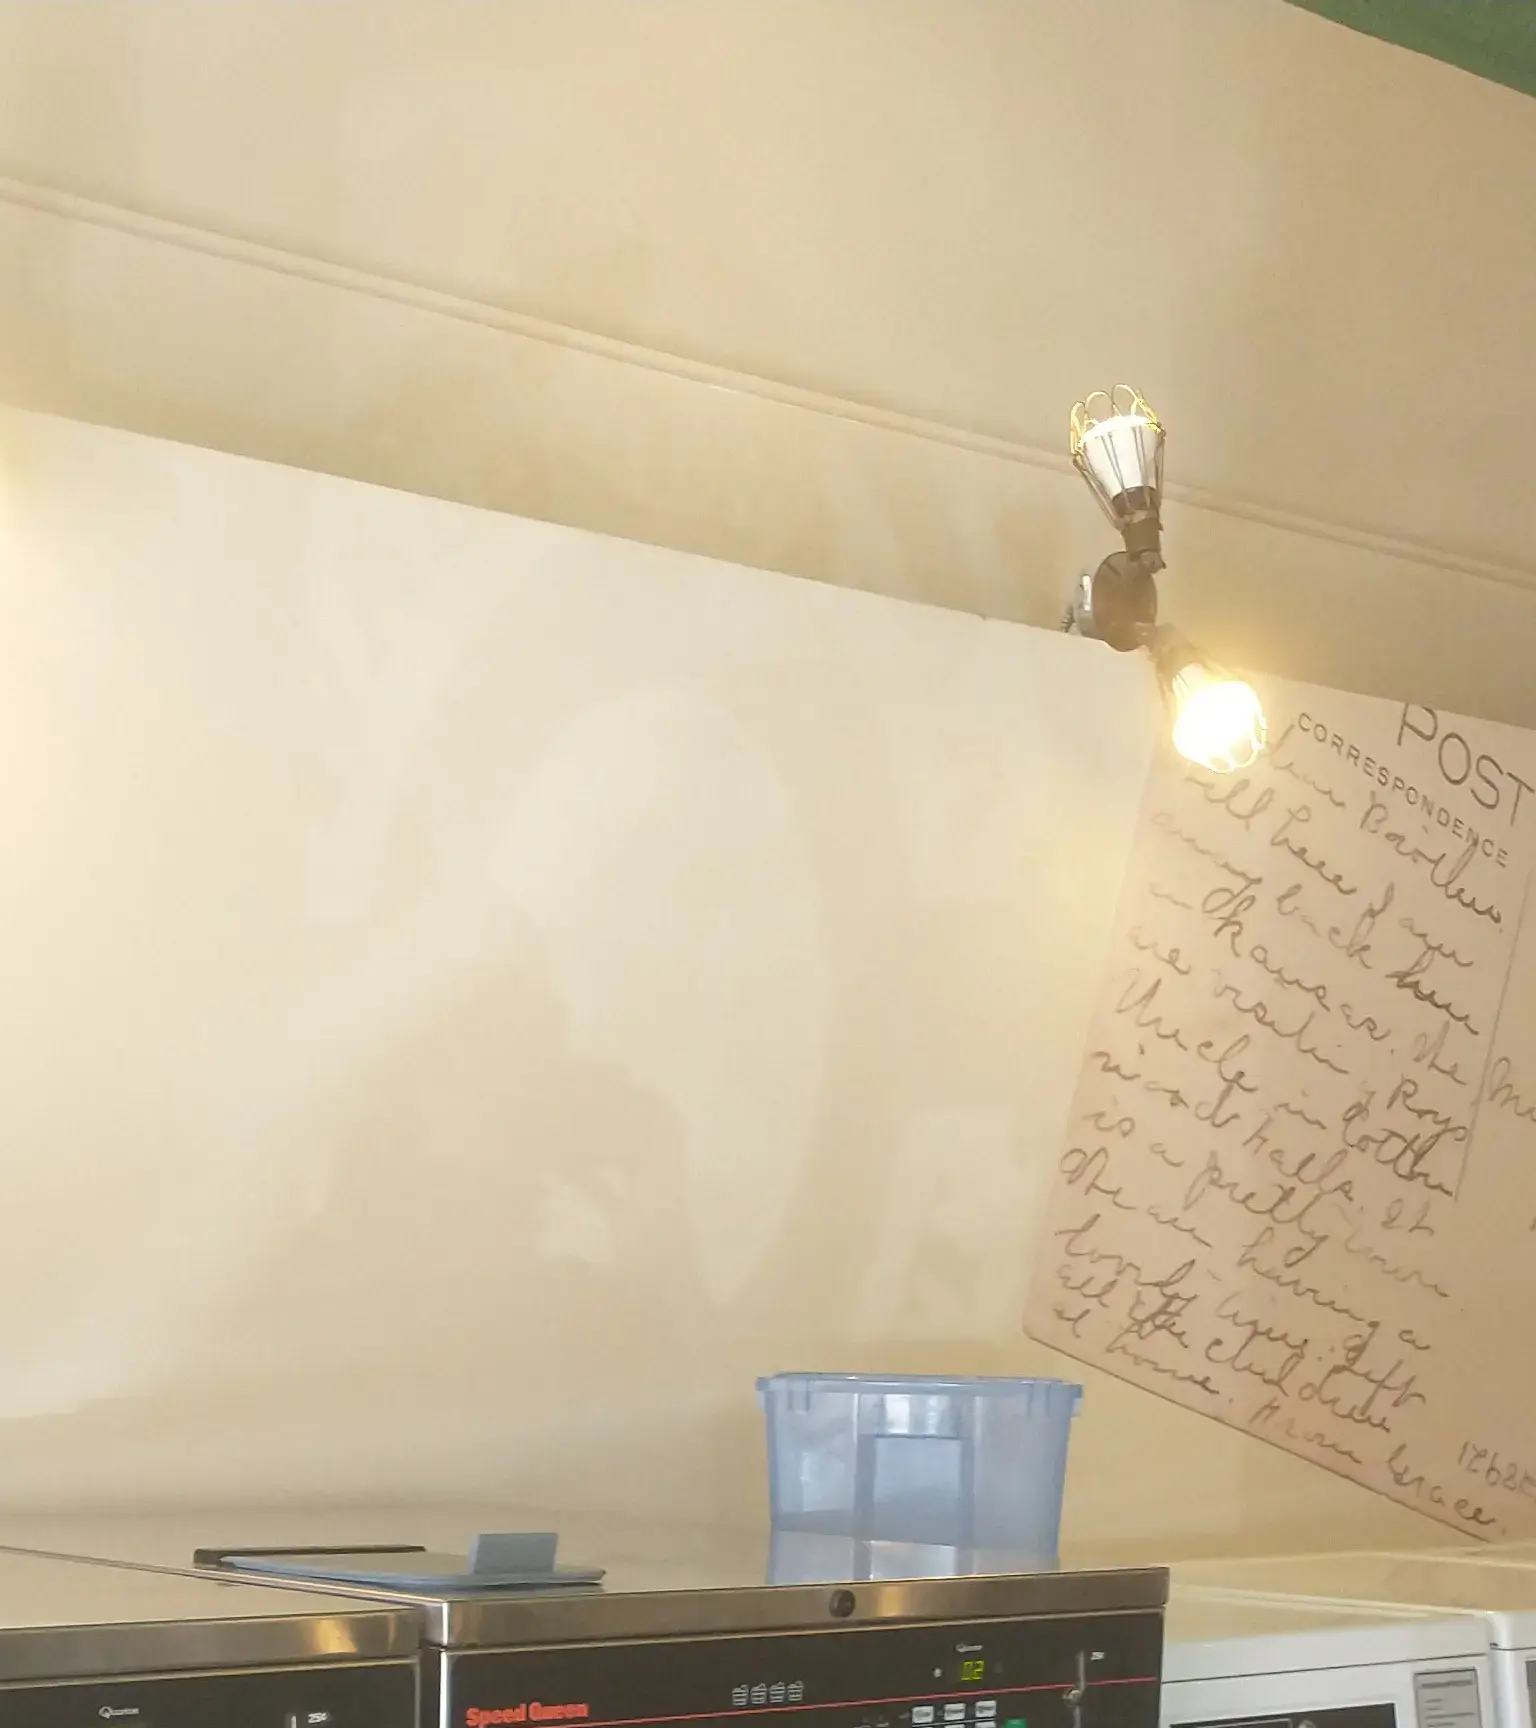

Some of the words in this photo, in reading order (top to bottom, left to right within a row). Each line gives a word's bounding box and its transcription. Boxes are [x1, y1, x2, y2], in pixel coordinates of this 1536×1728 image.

[1297, 711, 1509, 869] CORRESPONDENCE
[1396, 701, 1536, 827] POST
[465, 1703, 527, 1728] Speed
[528, 1701, 589, 1721] Queen
